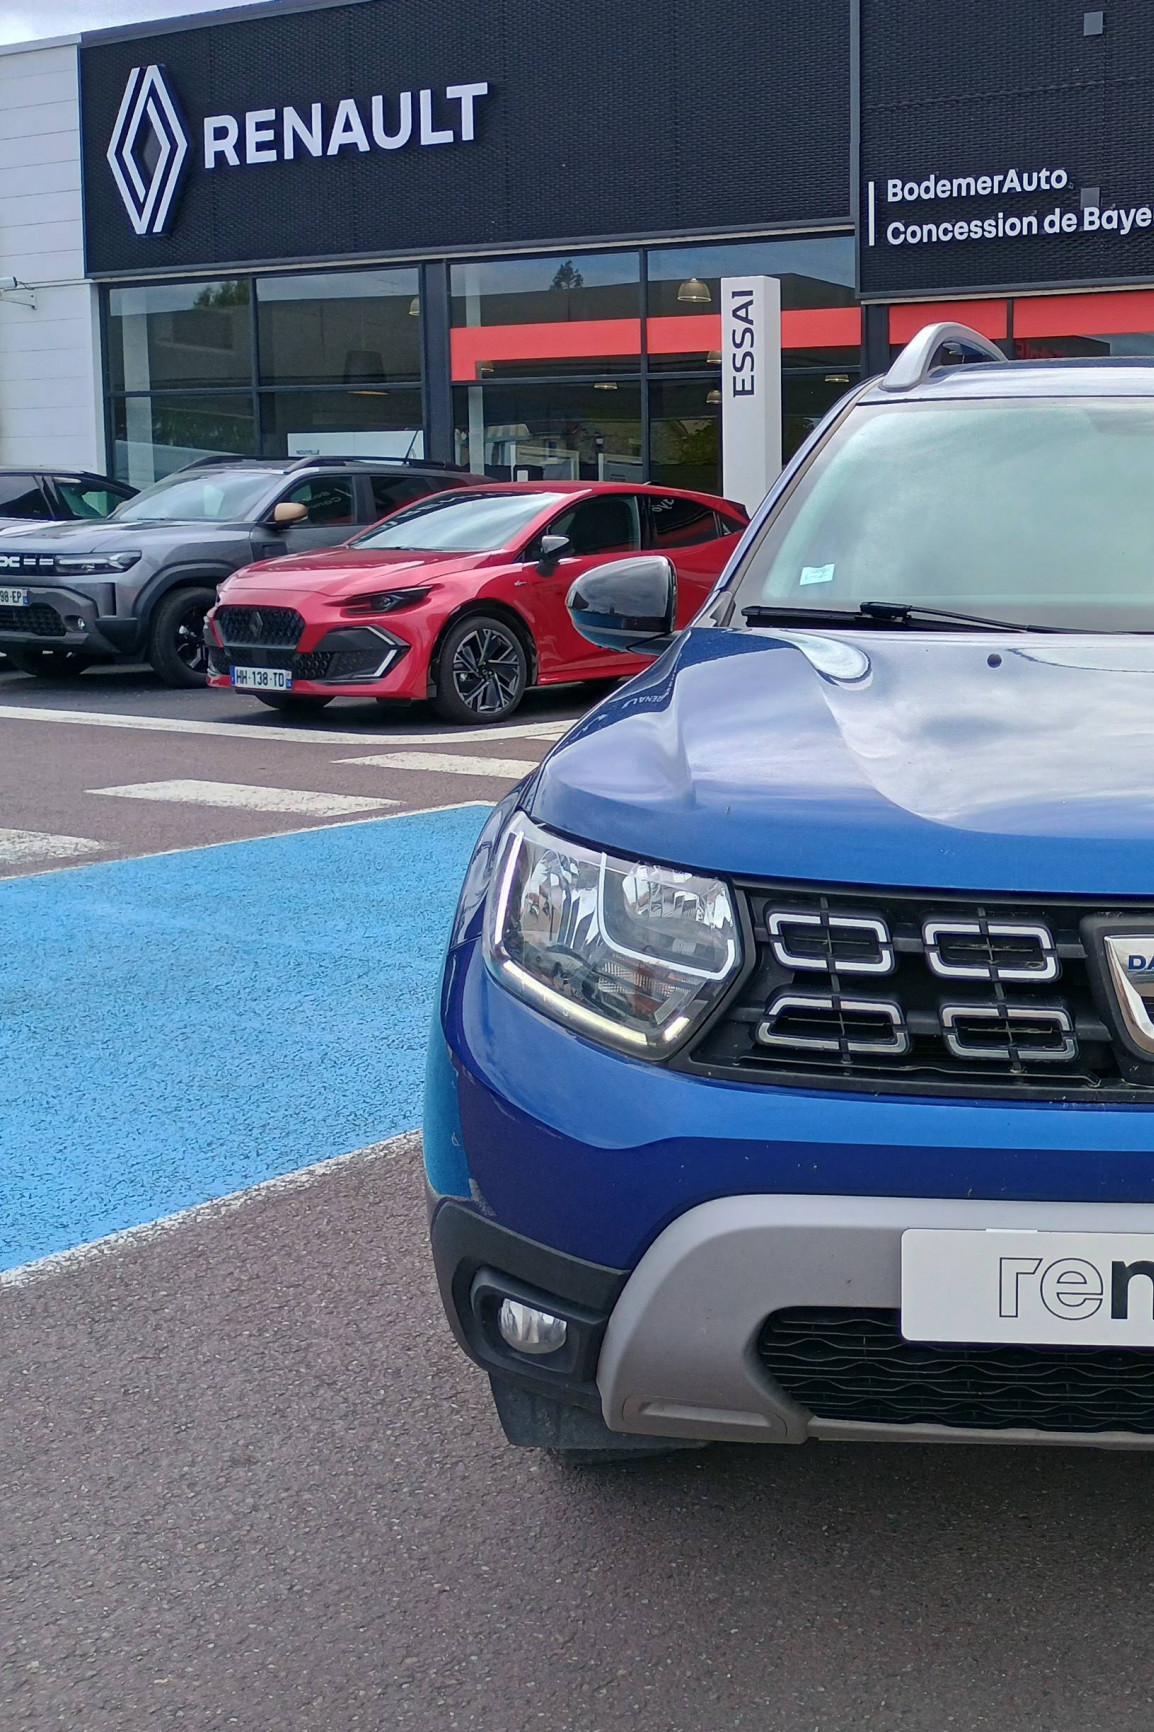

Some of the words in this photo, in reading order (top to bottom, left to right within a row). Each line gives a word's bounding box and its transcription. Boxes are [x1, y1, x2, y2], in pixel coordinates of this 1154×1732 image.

[203, 81, 489, 169] RENAULT
[887, 168, 1069, 202] BodemerAuto
[886, 213, 1038, 245] Concession
[1043, 208, 1078, 234] de
[731, 289, 755, 399] ESSAI
[236, 669, 285, 688] HH-138-TD
